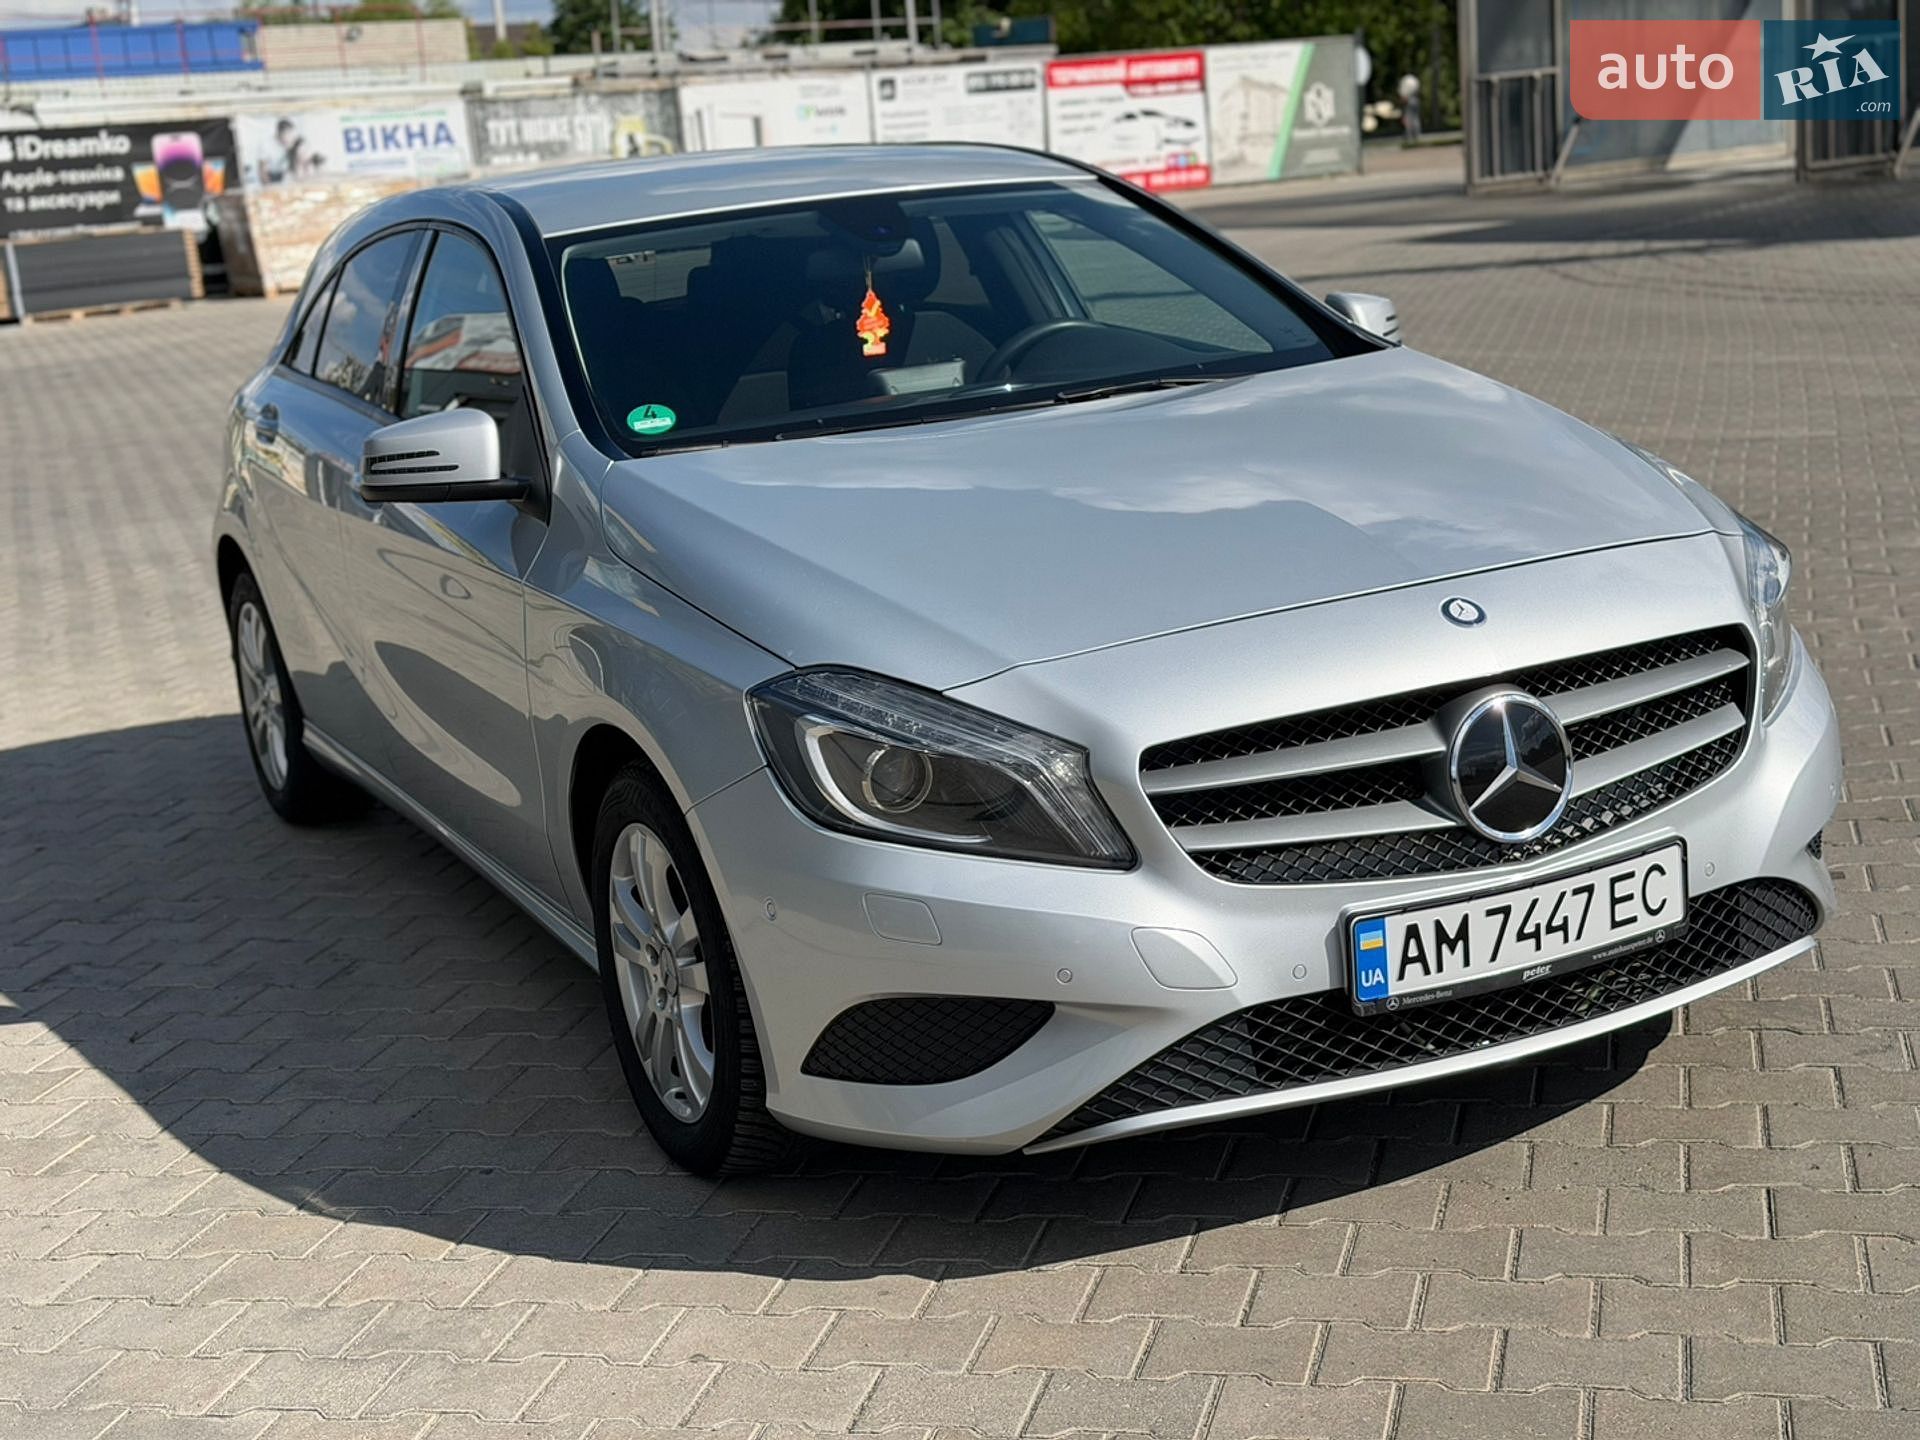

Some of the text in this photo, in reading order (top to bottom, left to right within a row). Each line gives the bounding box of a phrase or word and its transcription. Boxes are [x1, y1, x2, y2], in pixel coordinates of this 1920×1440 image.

[15, 130, 131, 161] iDreamko
[343, 121, 455, 153] ВІКНА
[1, 164, 125, 192] Apple-техніка
[27, 190, 121, 212] аксесуари
[643, 404, 657, 419] 4
[1396, 862, 1668, 982] AM 7447 EC
[1361, 967, 1386, 988] UA
[1402, 989, 1453, 1006] Mercedes-Benz
